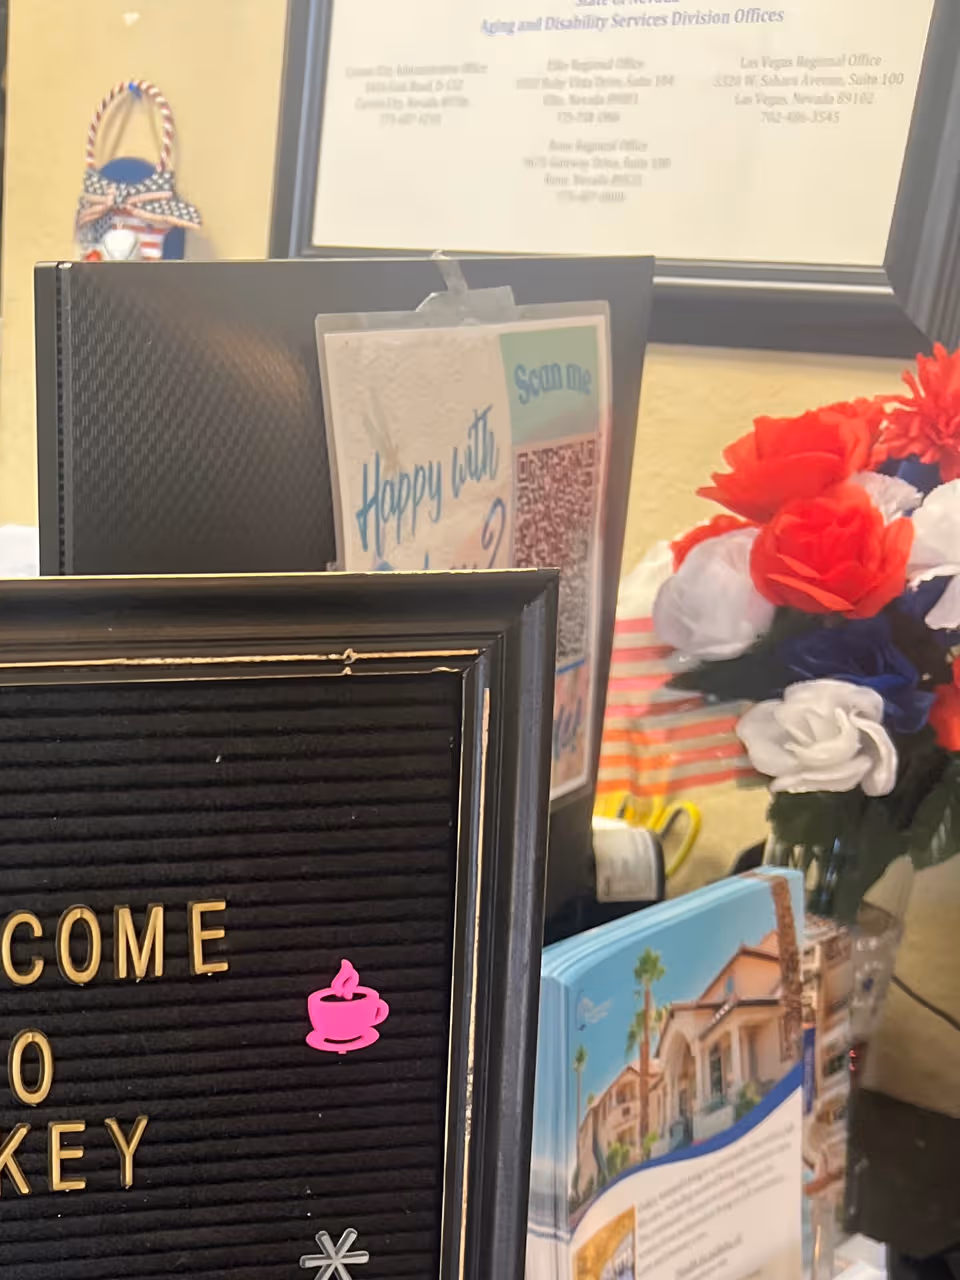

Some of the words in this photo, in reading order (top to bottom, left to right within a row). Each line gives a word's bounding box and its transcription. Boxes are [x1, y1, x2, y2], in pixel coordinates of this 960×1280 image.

[517, 17, 541, 32] and
[544, 14, 608, 32] Disability
[611, 11, 667, 29] Services
[671, 8, 730, 26] Division
[734, 6, 785, 24] Offices
[740, 57, 758, 69] Las
[761, 56, 793, 70] Vegas
[848, 53, 882, 67] Office
[882, 72, 905, 86] 100
[514, 362, 563, 405] Scan
[566, 362, 592, 396] me
[355, 449, 442, 560] Happy
[451, 403, 500, 499] with
